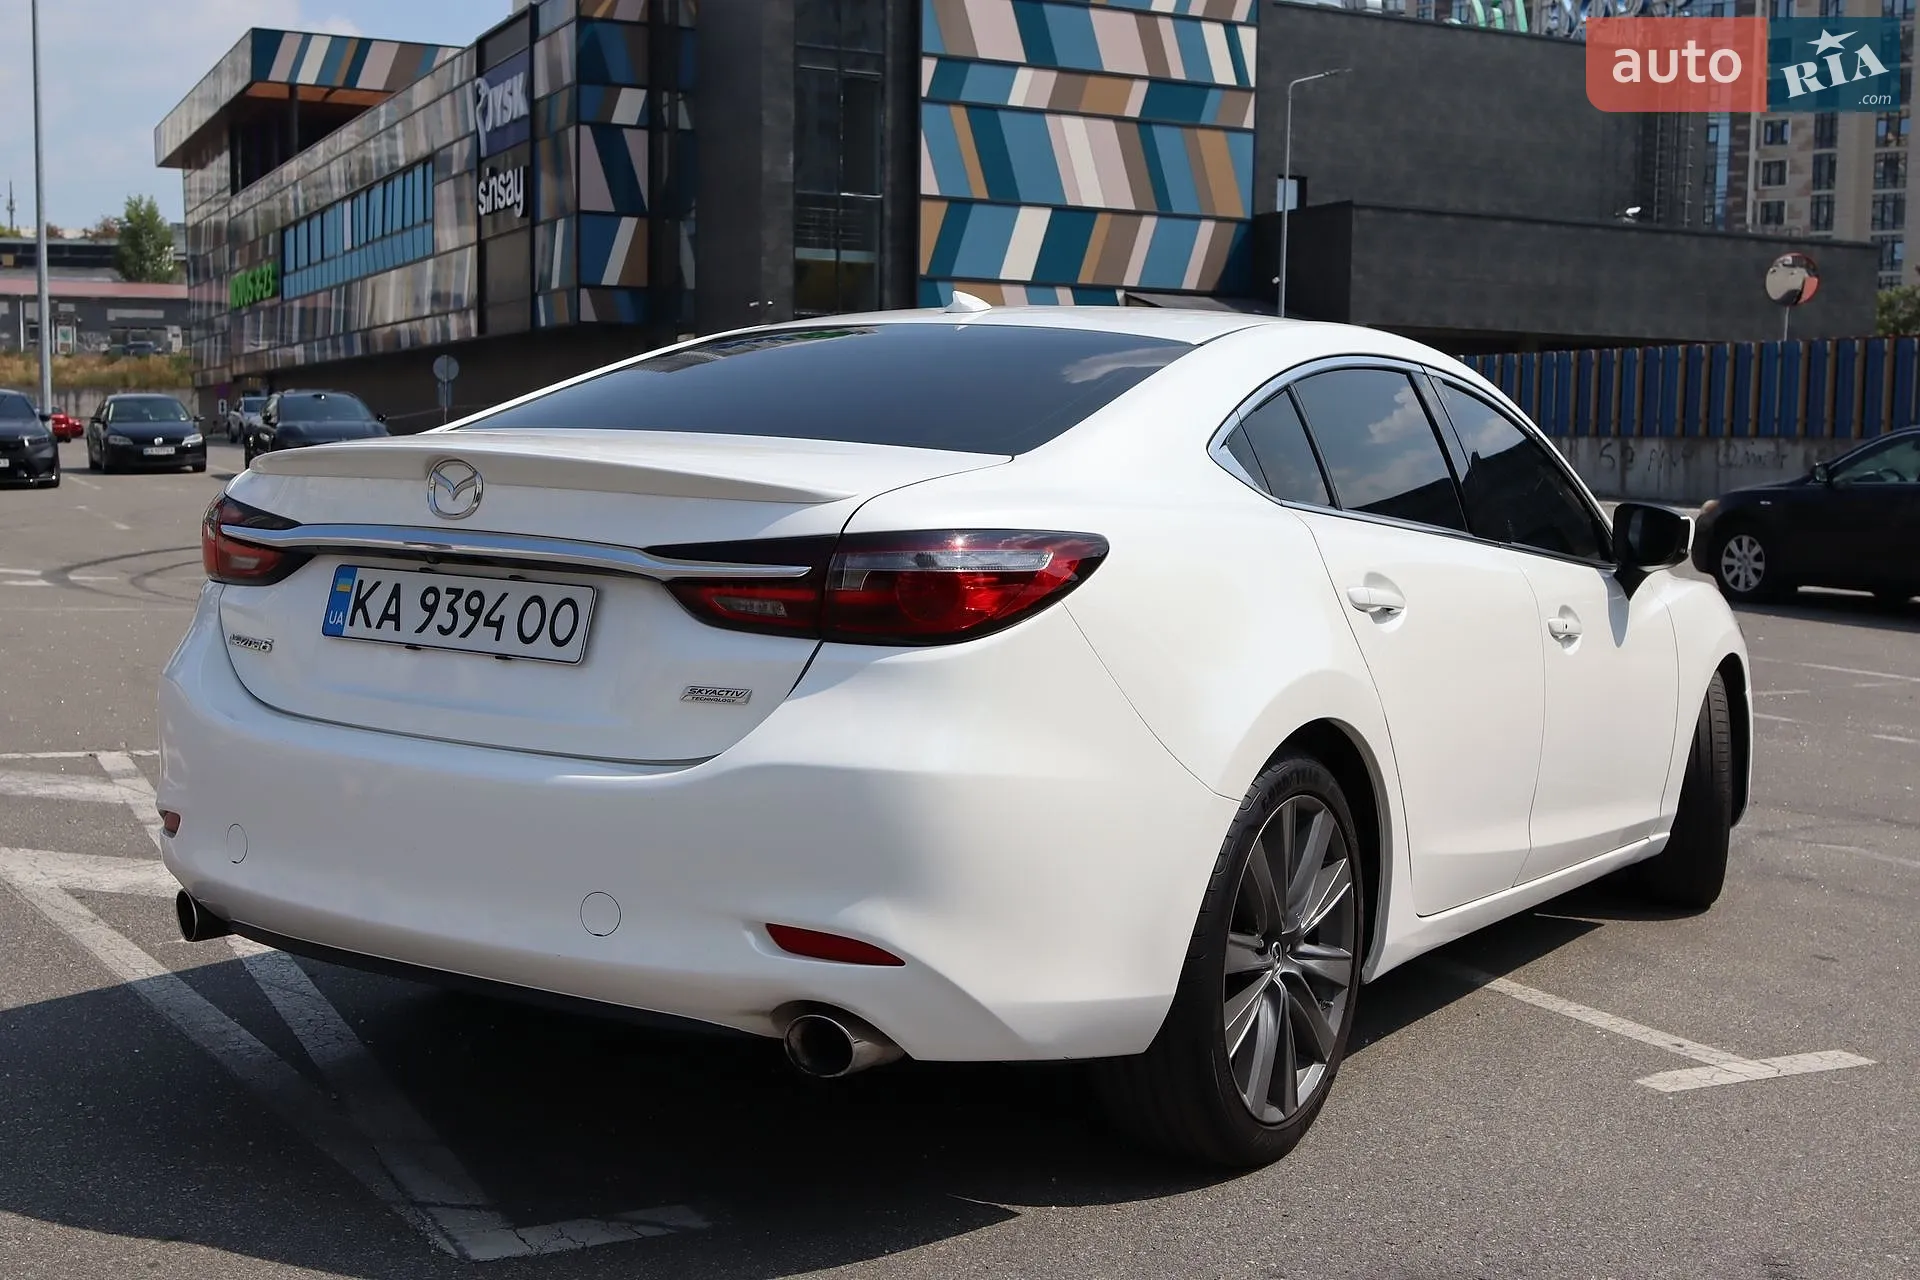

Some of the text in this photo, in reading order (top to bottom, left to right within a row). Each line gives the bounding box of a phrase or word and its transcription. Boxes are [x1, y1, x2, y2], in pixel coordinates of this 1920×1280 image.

[485, 72, 530, 132] JYSK
[478, 166, 524, 218] sinsay
[328, 611, 344, 626] UA
[348, 580, 401, 632] KA
[414, 586, 508, 642] 9394
[687, 687, 745, 697] SKYACTIV
